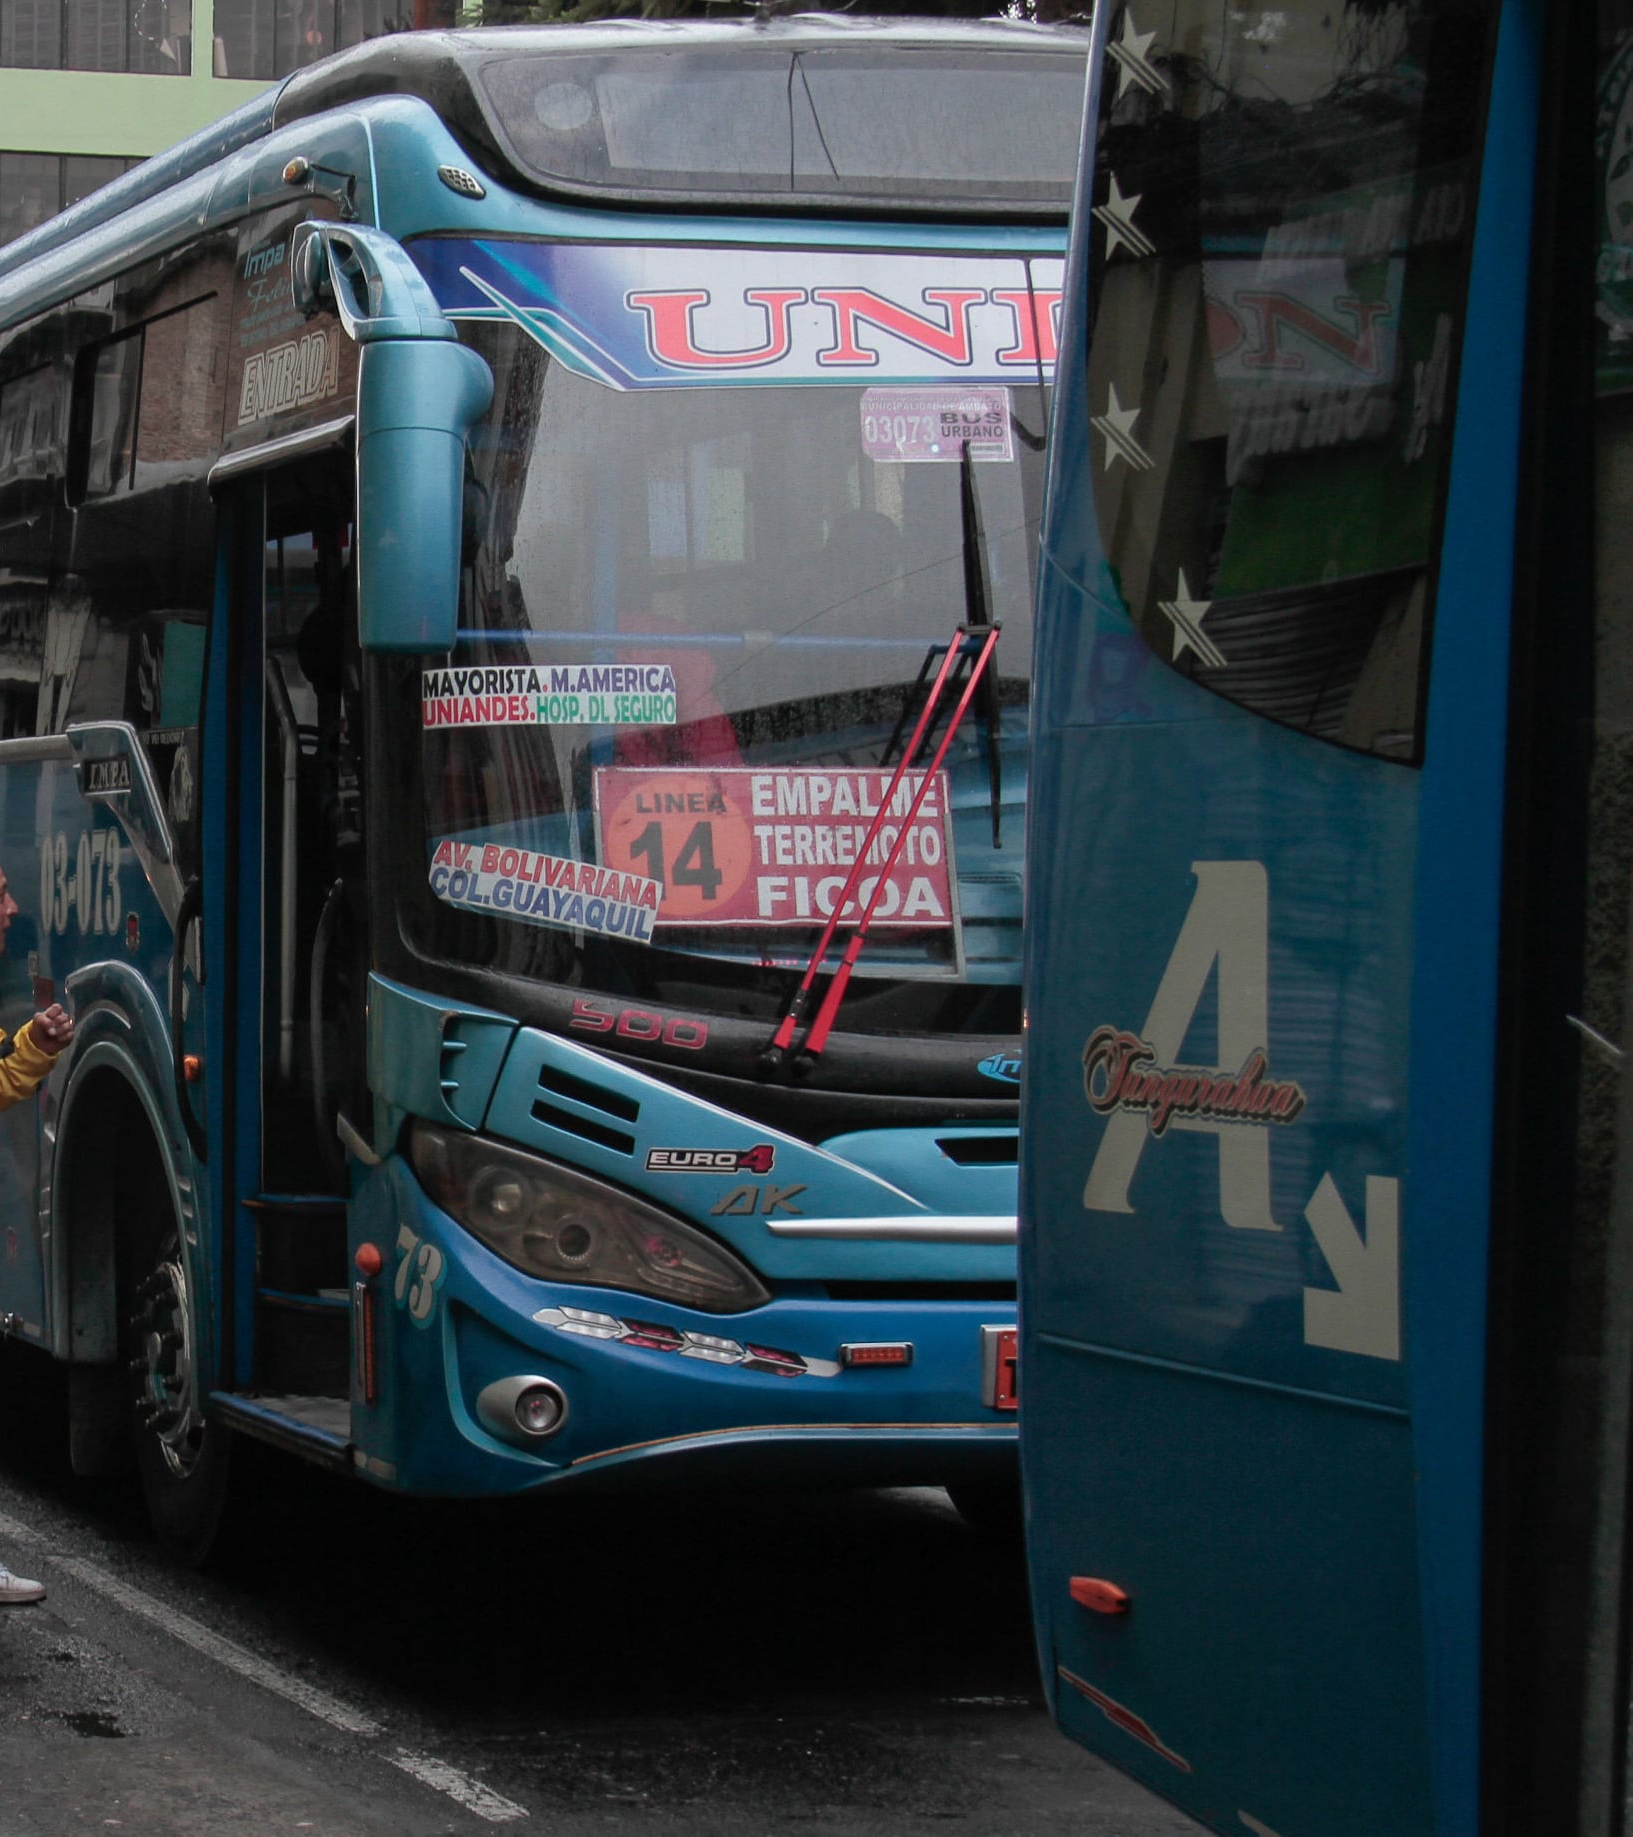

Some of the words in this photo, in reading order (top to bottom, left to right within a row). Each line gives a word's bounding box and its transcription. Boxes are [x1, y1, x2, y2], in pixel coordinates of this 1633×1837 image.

[244, 242, 285, 280] Impa
[237, 325, 341, 426] ENTRADA
[865, 415, 936, 445] 03073
[940, 412, 1002, 424] BUS
[941, 426, 1004, 438] URBANO
[589, 695, 610, 722] DL
[614, 695, 676, 722] SEGURO
[88, 760, 130, 790] IMPA
[636, 793, 727, 814] LINEA
[751, 776, 939, 817] EMPALME
[629, 820, 723, 900] 14
[753, 825, 940, 865] TERREMOTO
[40, 826, 121, 936] 03-073
[433, 840, 474, 869] AV.
[480, 846, 657, 910] BOLIVARIANA
[757, 876, 945, 918] FICOA
[569, 998, 709, 1050] 500
[1083, 860, 1284, 1232] A
[1083, 1025, 1308, 1139] Tungurahua
[710, 1183, 807, 1216] AK
[394, 1222, 443, 1320] 73
